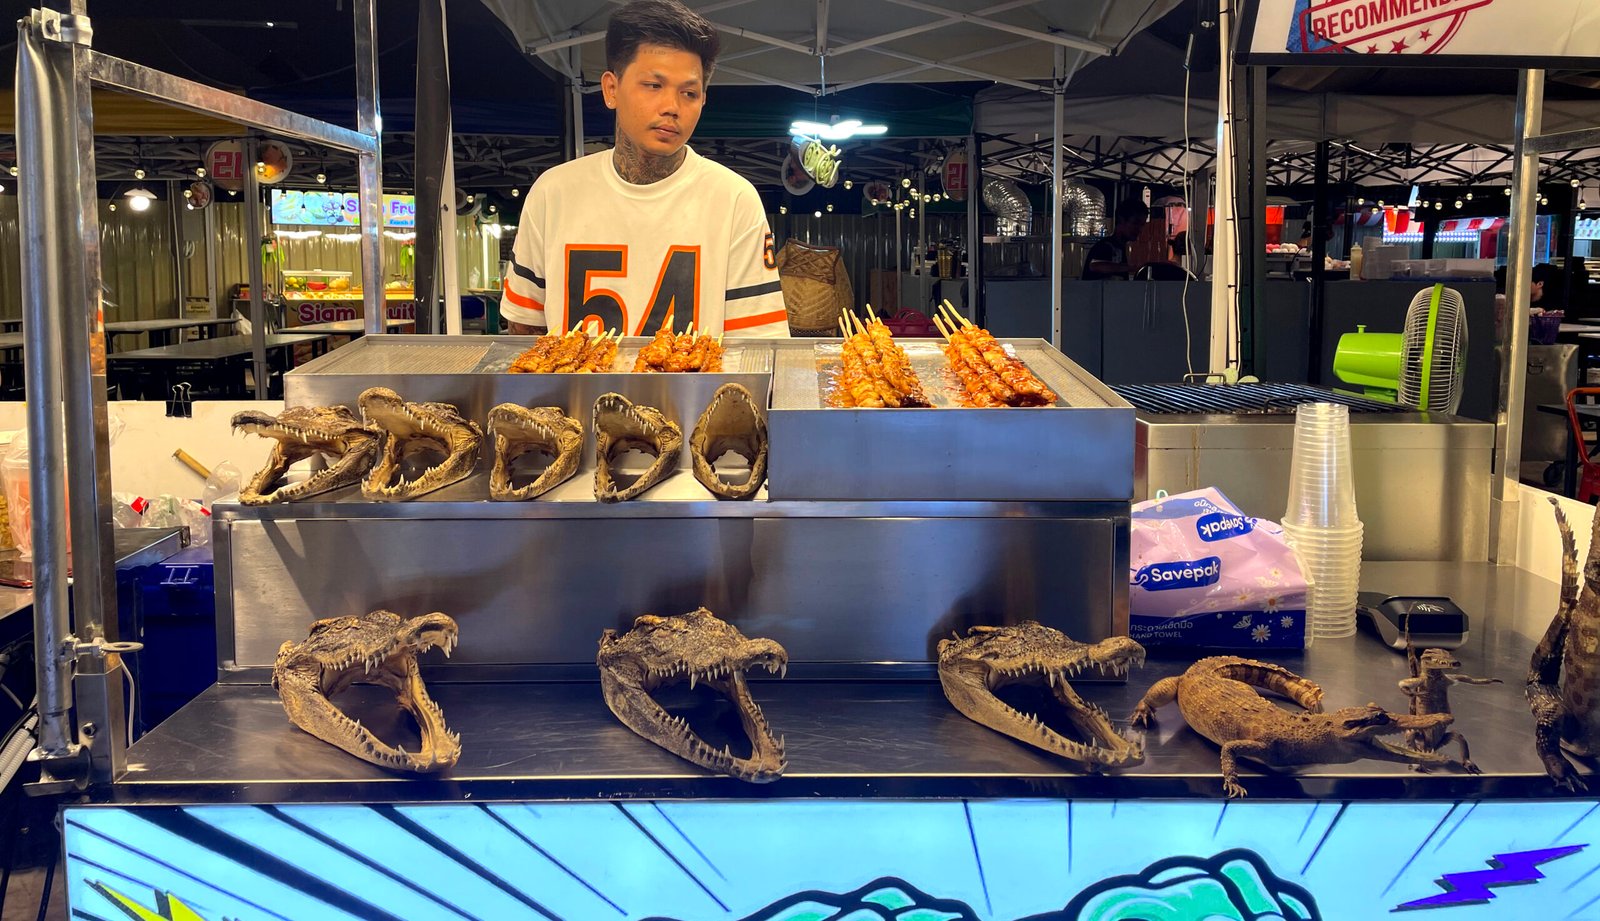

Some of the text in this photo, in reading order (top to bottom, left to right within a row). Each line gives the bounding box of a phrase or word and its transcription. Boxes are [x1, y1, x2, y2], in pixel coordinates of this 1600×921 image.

[1313, 0, 1456, 42] RECOMME
[563, 243, 701, 336] 54
[299, 303, 415, 322] Siam uit
[1200, 516, 1245, 538] Savepak
[1151, 560, 1219, 582] Savepak
[1154, 631, 1182, 639] TOWEL
